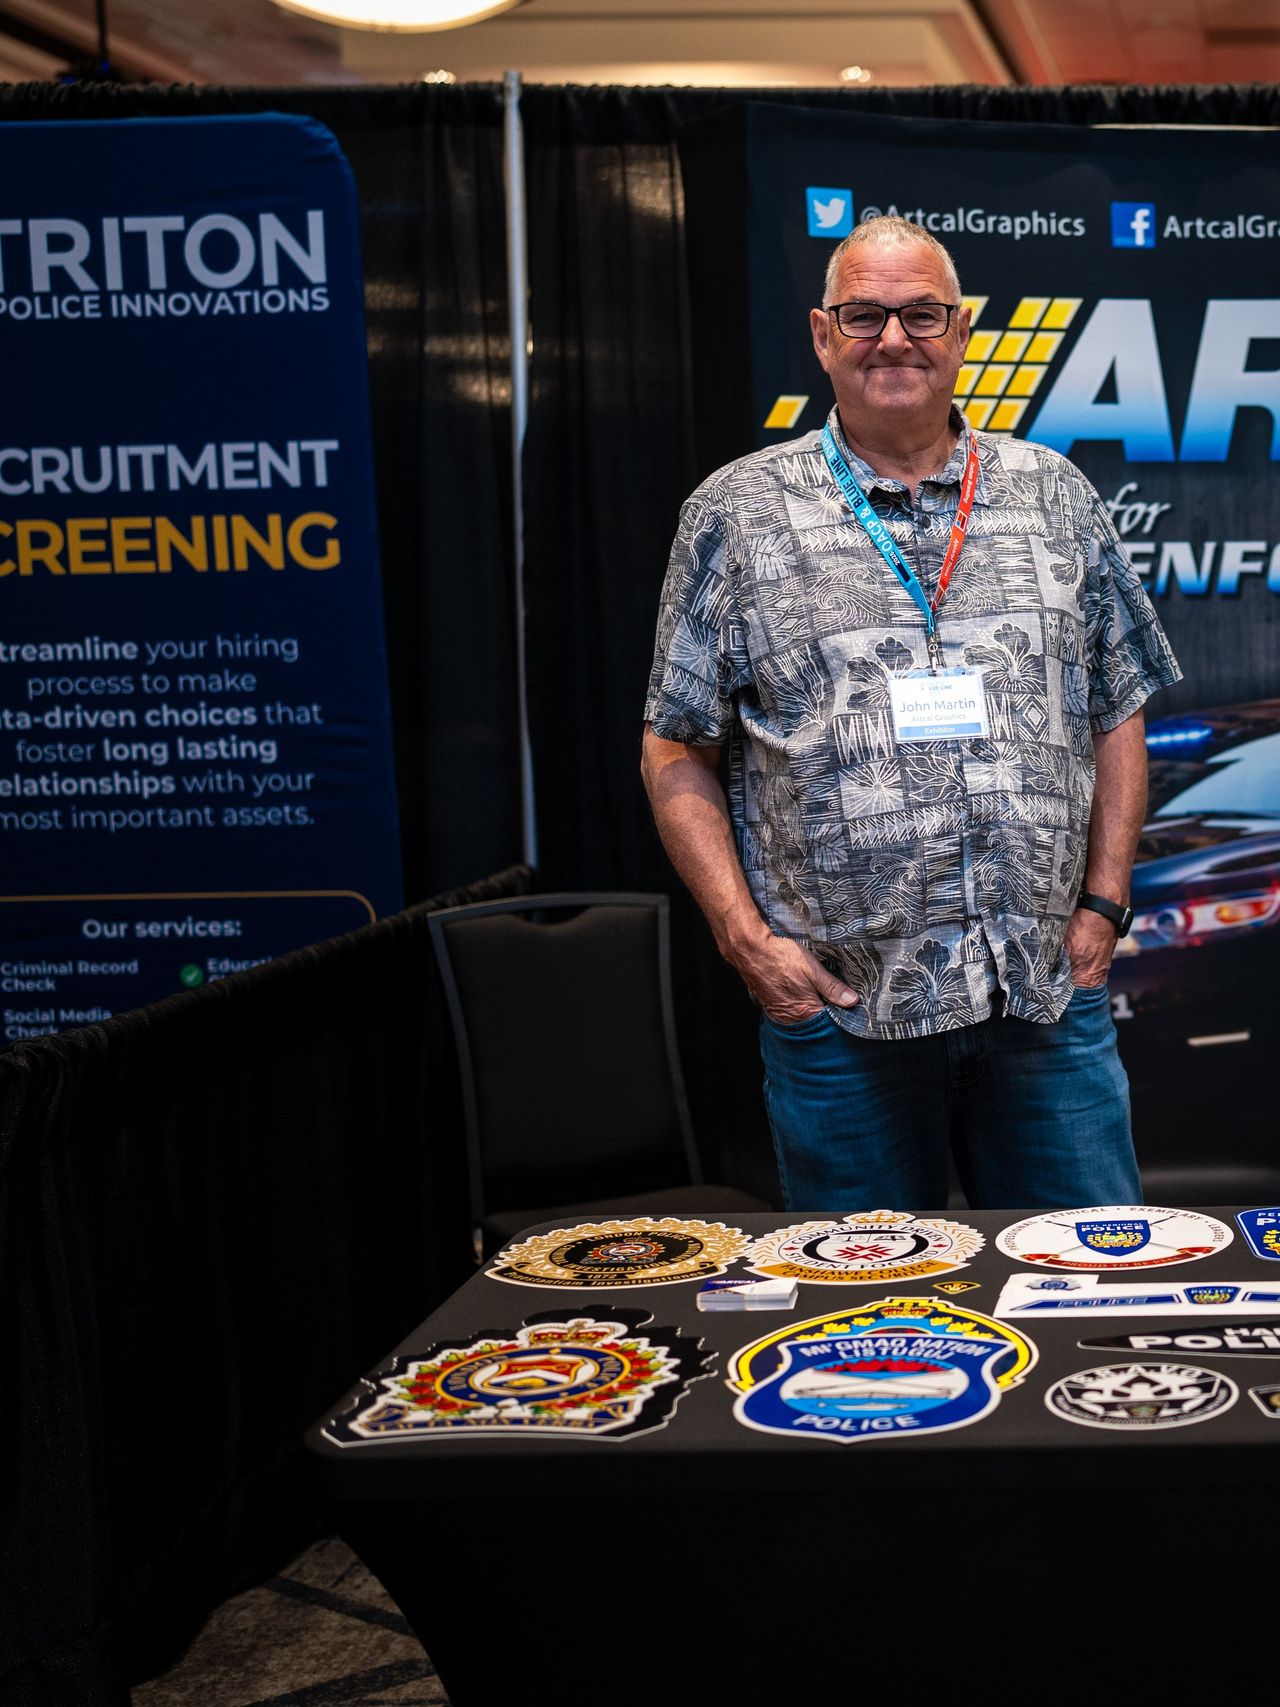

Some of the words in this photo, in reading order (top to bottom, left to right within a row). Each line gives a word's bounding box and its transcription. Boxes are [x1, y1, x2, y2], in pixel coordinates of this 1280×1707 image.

[0, 295, 102, 320] OLICE
[111, 287, 330, 318] INNOVATIONS
[820, 430, 836, 459] EXPO
[831, 455, 849, 484] LINE
[842, 480, 864, 509] BLUE
[860, 506, 872, 519] &
[1105, 482, 1172, 535] for
[866, 520, 893, 553] OACP
[145, 640, 207, 664] your
[215, 633, 299, 662] hiring
[27, 676, 135, 701] process
[141, 672, 170, 693] to
[179, 669, 257, 692] make
[0, 705, 136, 730] ta-driven
[145, 702, 258, 728] choices
[265, 701, 324, 726] that
[899, 701, 930, 713] John
[934, 698, 976, 711] Martin
[925, 726, 956, 735] Exhibitor
[16, 739, 97, 763] foster
[103, 738, 169, 766] long
[177, 735, 278, 764] lasting
[182, 770, 245, 793] with
[252, 773, 315, 798] your
[71, 805, 214, 834] important
[220, 804, 315, 827] assets.
[82, 919, 128, 939] Our
[135, 916, 242, 938] services:
[0, 960, 74, 977] Criminal
[77, 959, 140, 975] Record
[1, 977, 57, 992] Check
[4, 1008, 56, 1025] Social
[59, 1007, 112, 1023] Media
[1049, 1207, 1108, 1219] ETHICAL
[1129, 1207, 1204, 1221] EXEMPLARY
[586, 1231, 643, 1242] LONDON
[647, 1231, 692, 1241] POLICE
[791, 1224, 896, 1245] COMMUNITY
[900, 1225, 946, 1242] DRIVEN
[562, 1261, 671, 1273] INVESTIGATION
[780, 1264, 860, 1276] FANSHAWE
[867, 1261, 939, 1275] COLLEGE
[784, 1252, 852, 1269] STUDENT
[859, 1250, 940, 1269] FOCUSED
[781, 1270, 848, 1280] CAMPUS
[856, 1269, 927, 1280] SECURITY
[911, 1338, 992, 1357] NATION
[792, 1413, 922, 1431] POLICE
